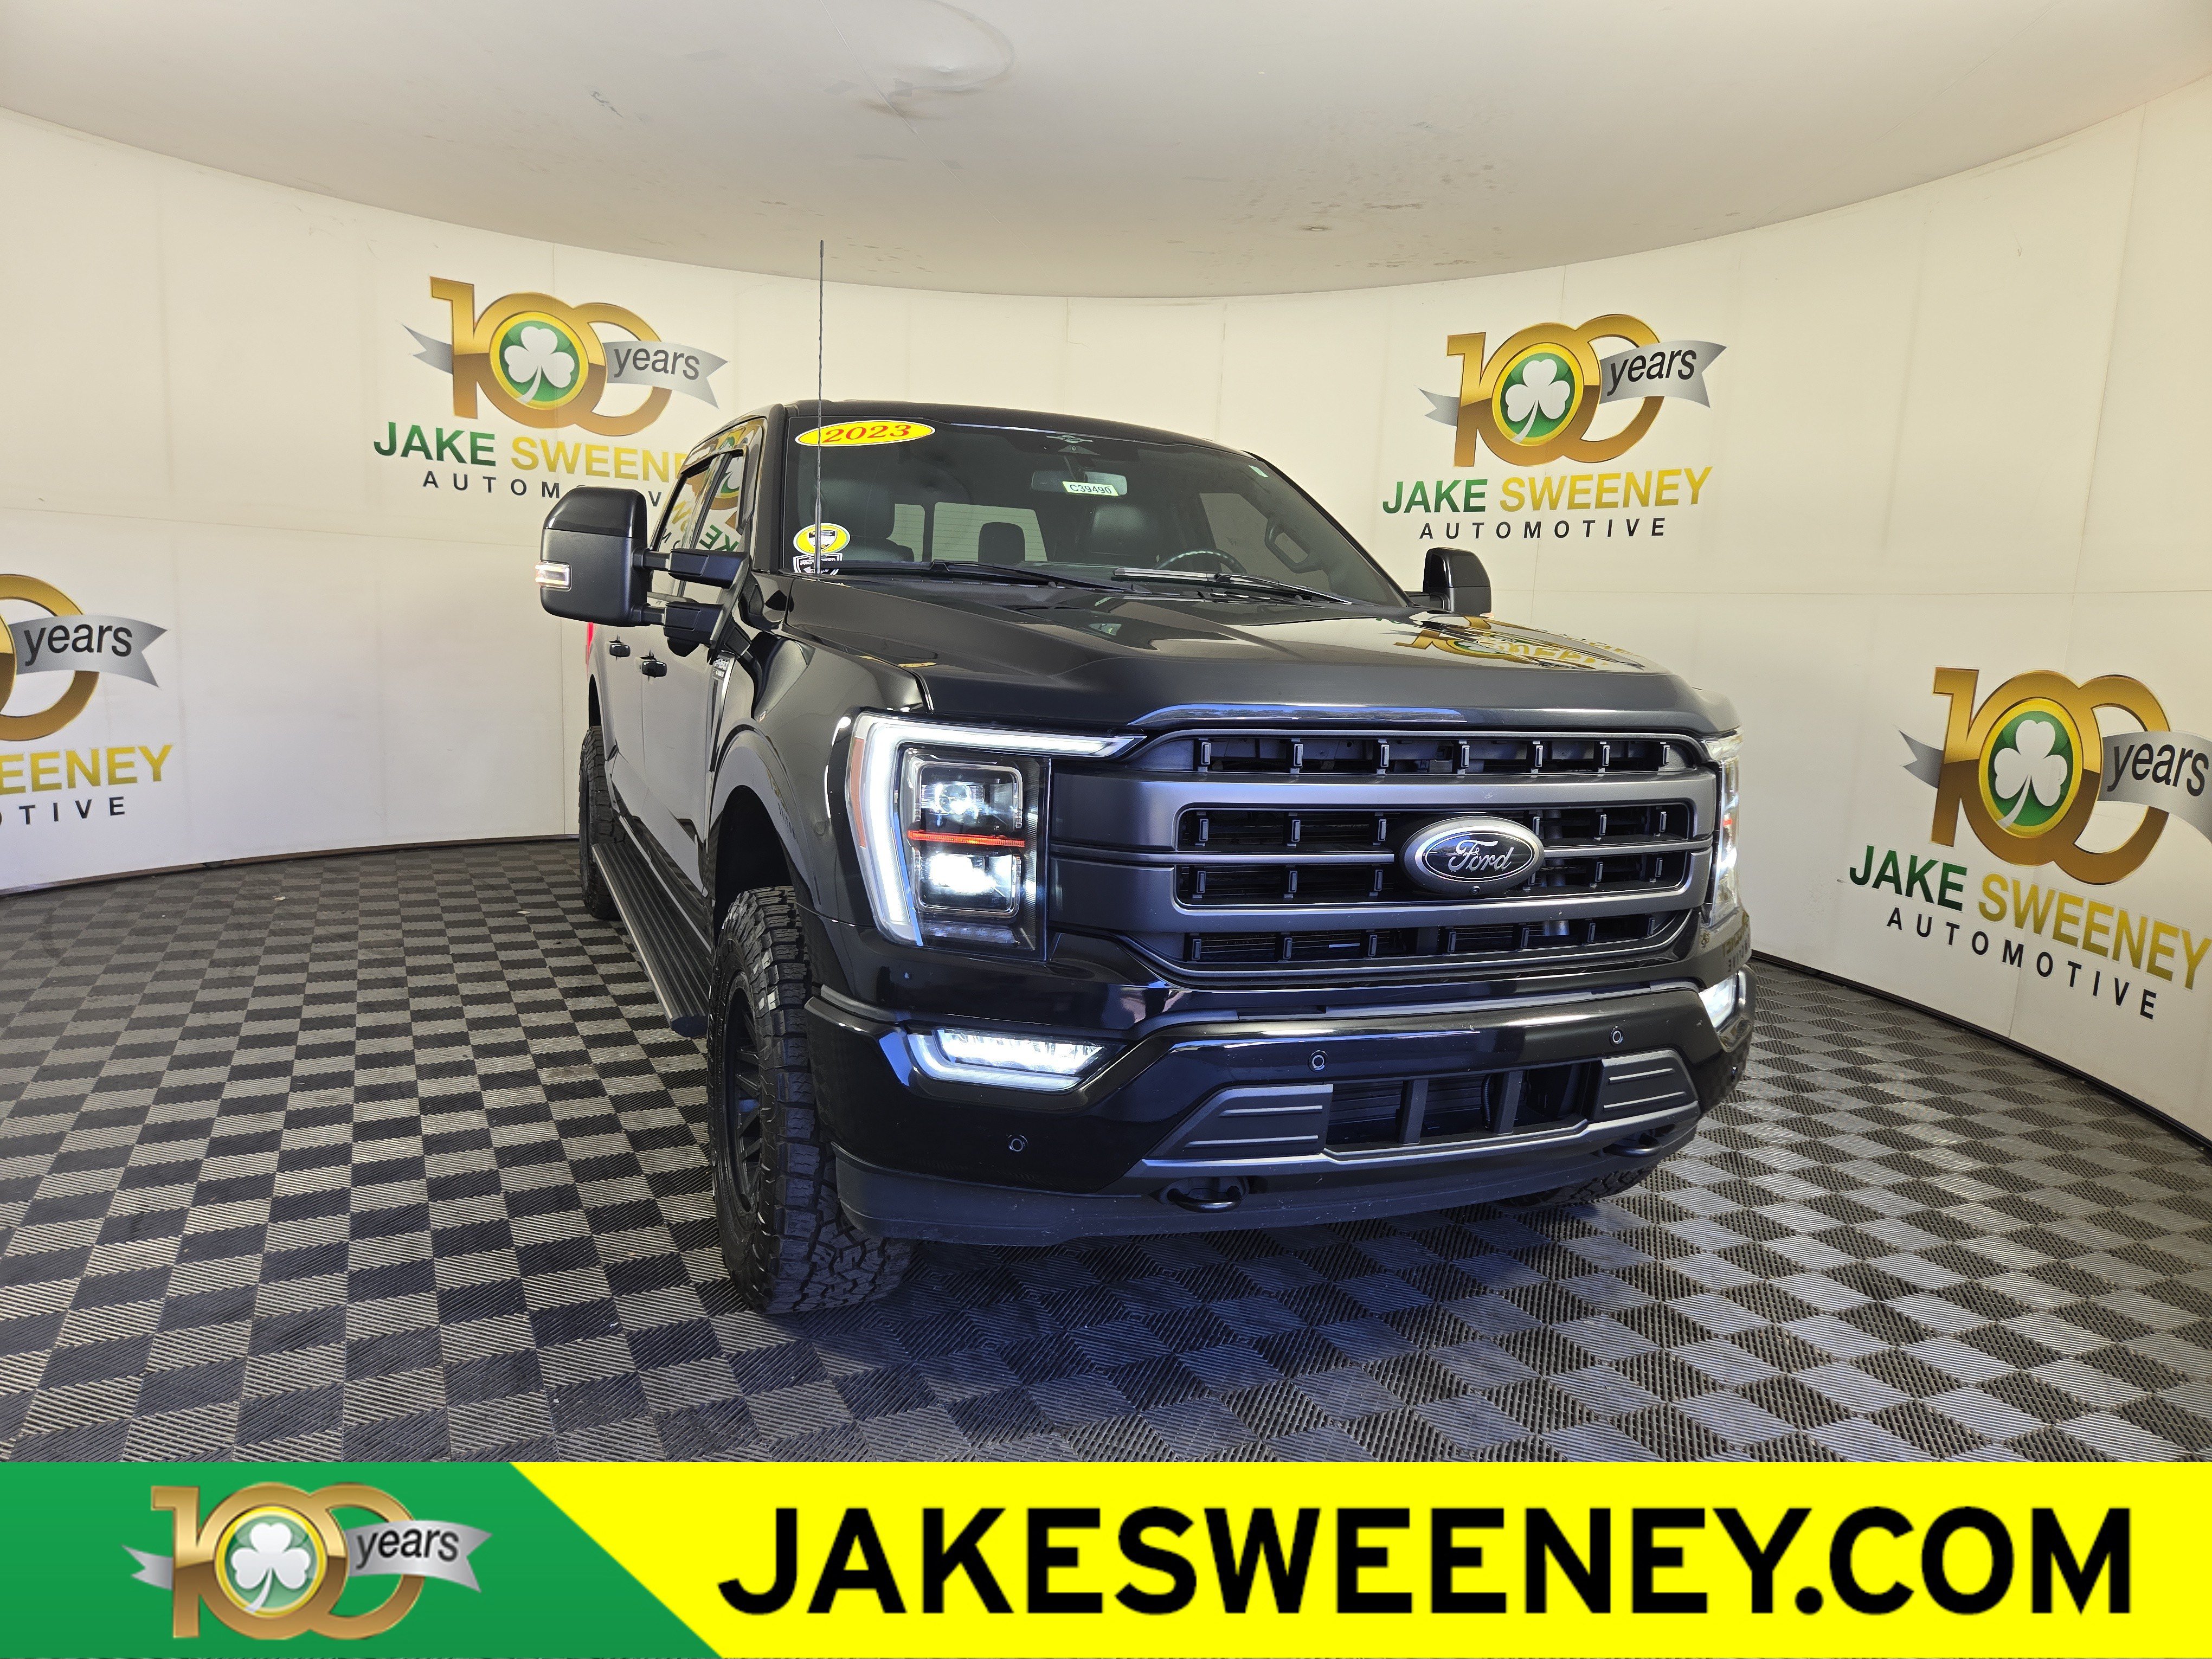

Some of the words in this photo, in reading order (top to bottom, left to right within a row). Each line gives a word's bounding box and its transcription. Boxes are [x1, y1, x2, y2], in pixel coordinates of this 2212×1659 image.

[613, 345, 700, 380] years
[1606, 348, 1696, 396] years
[374, 421, 496, 467] JAKE
[511, 436, 687, 483] SWEEN
[822, 425, 912, 443] 2023
[1070, 484, 1112, 494] C39490
[1382, 479, 1488, 514] JAKE
[1500, 466, 1713, 512] SWEENEY
[1420, 517, 1666, 539] AUTOMOTIVE
[23, 623, 133, 666] years
[2106, 742, 2210, 796] years
[1448, 839, 1514, 872] Ford
[1849, 845, 1967, 911] JAKE
[1978, 872, 2212, 990] SWEENEY
[1886, 907, 2157, 1020] AUTOMOTIVE
